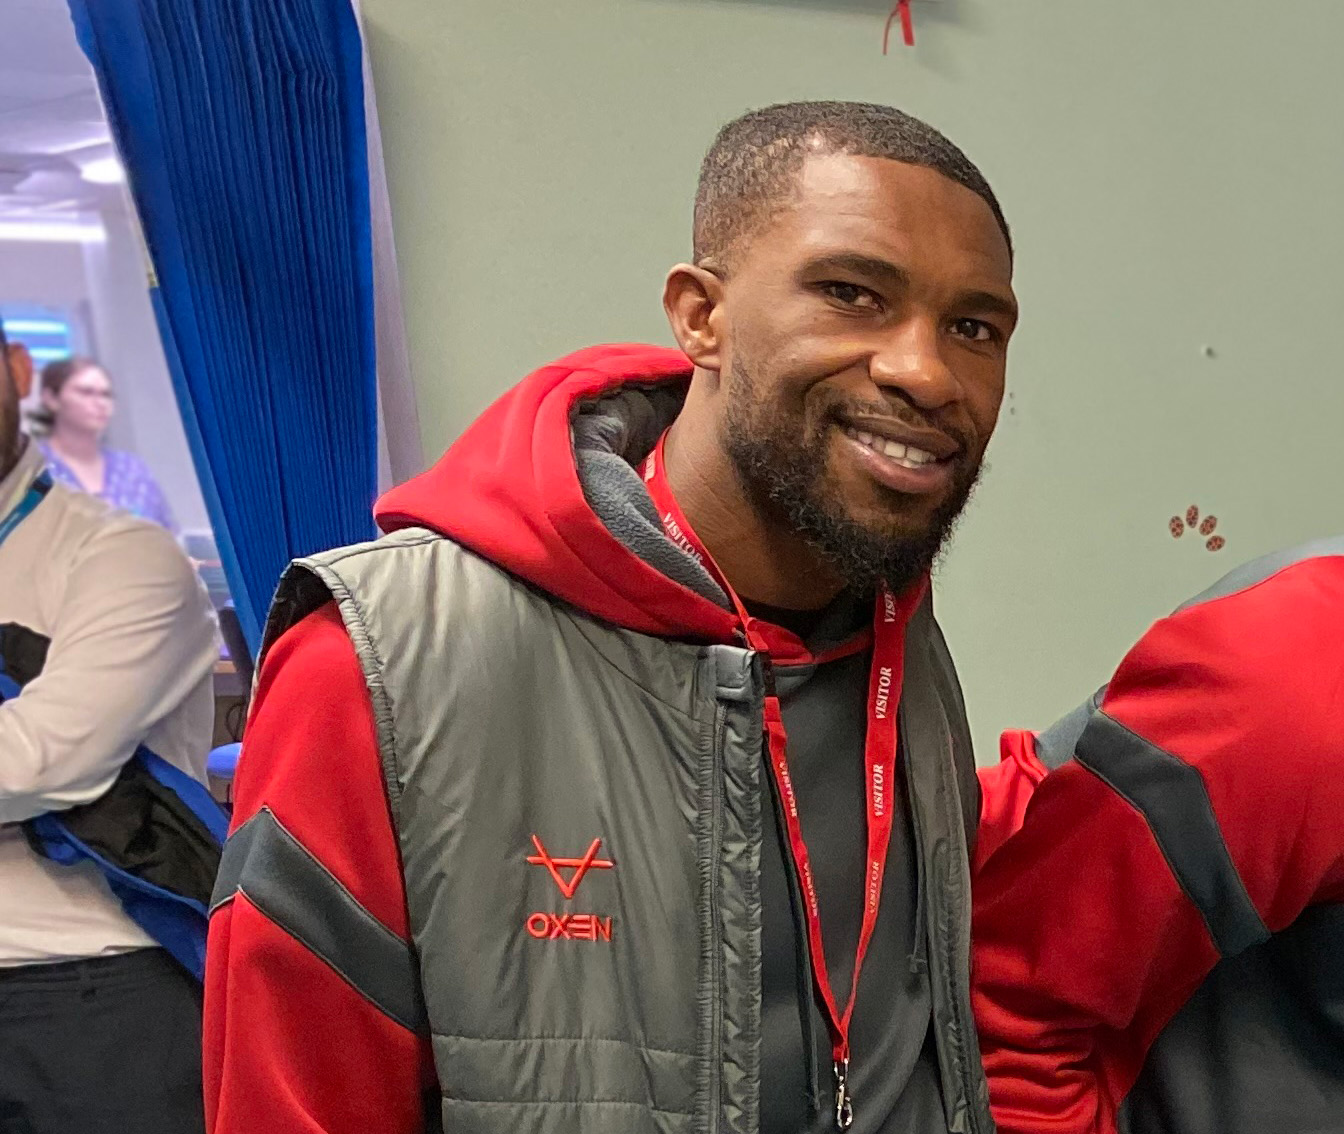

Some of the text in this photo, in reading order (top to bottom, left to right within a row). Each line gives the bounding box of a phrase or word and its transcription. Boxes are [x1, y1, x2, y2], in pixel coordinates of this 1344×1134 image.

[875, 666, 892, 719] VISITOR
[873, 763, 884, 817] VISITOR
[869, 861, 880, 914] VISITOR
[527, 912, 612, 943] OXEN
